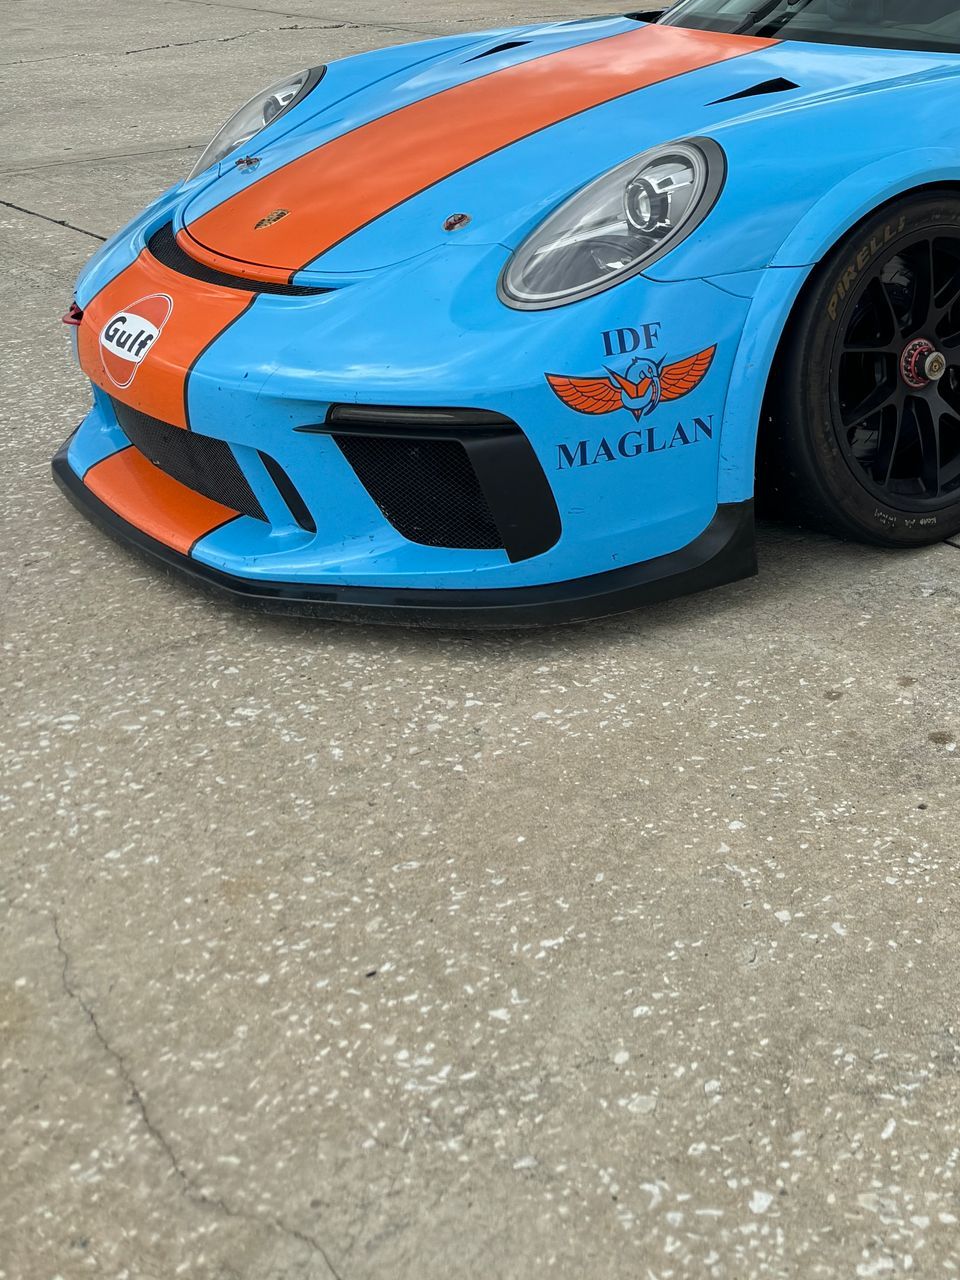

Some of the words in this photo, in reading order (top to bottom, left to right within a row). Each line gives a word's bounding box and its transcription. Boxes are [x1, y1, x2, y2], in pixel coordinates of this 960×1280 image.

[104, 316, 154, 357] Gulf
[601, 322, 661, 357] IDF
[556, 415, 715, 470] MAGLAN
